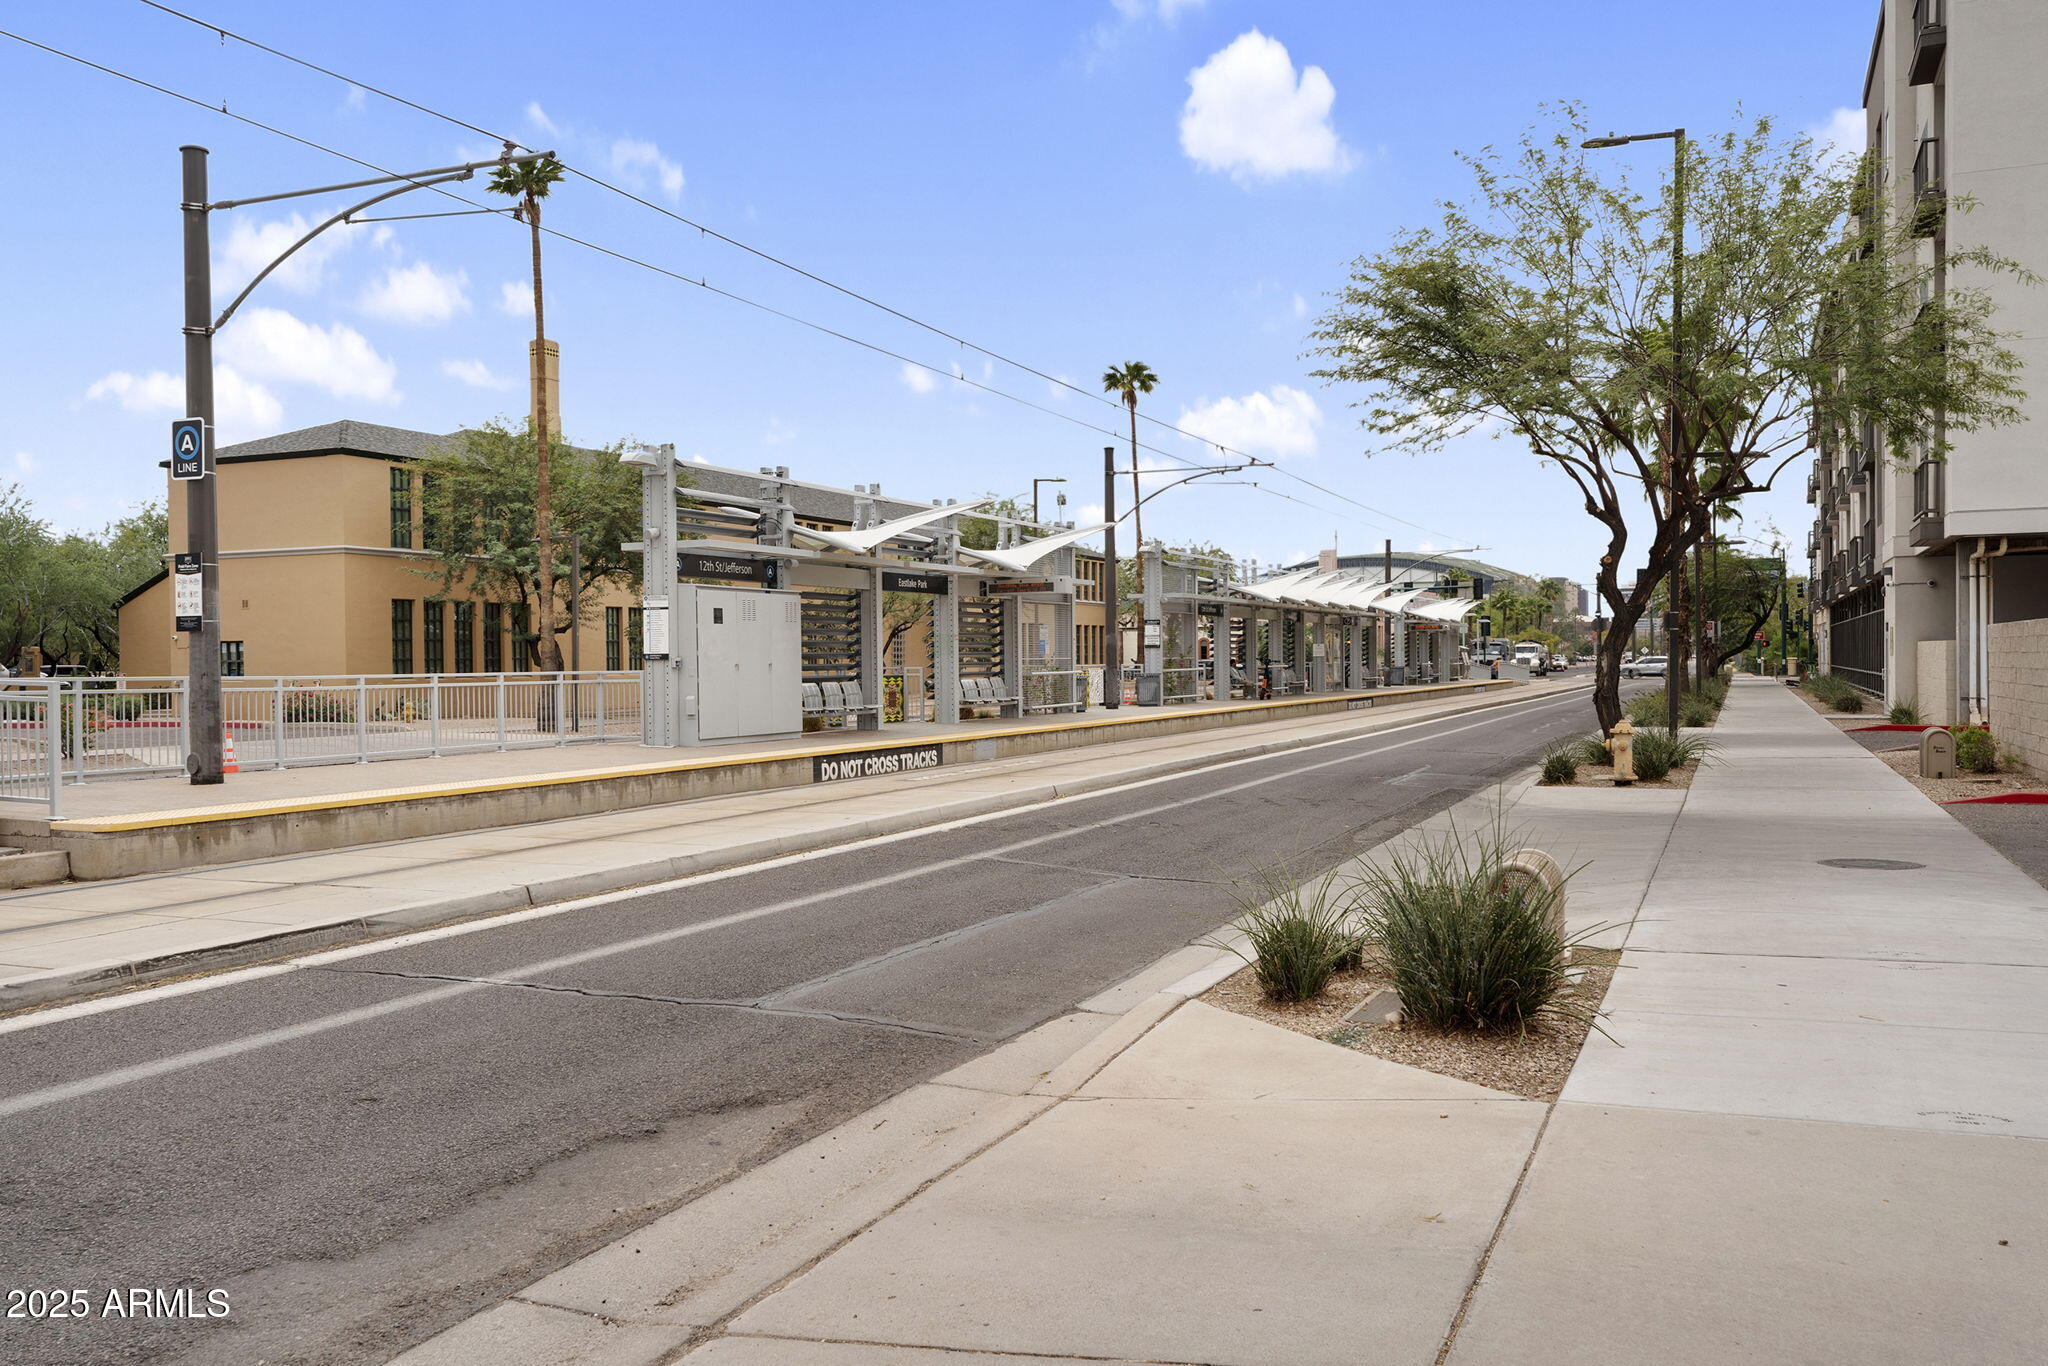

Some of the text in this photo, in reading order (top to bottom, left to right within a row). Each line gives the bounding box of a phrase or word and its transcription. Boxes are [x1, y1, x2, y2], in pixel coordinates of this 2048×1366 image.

[181, 434, 194, 452] A
[178, 462, 198, 473] LINE
[699, 560, 715, 572] 12th
[715, 561, 753, 575] St/Jefferson
[898, 578, 928, 589] Eastlake Park
[821, 749, 938, 782] DO NOT CROSS TRACKS
